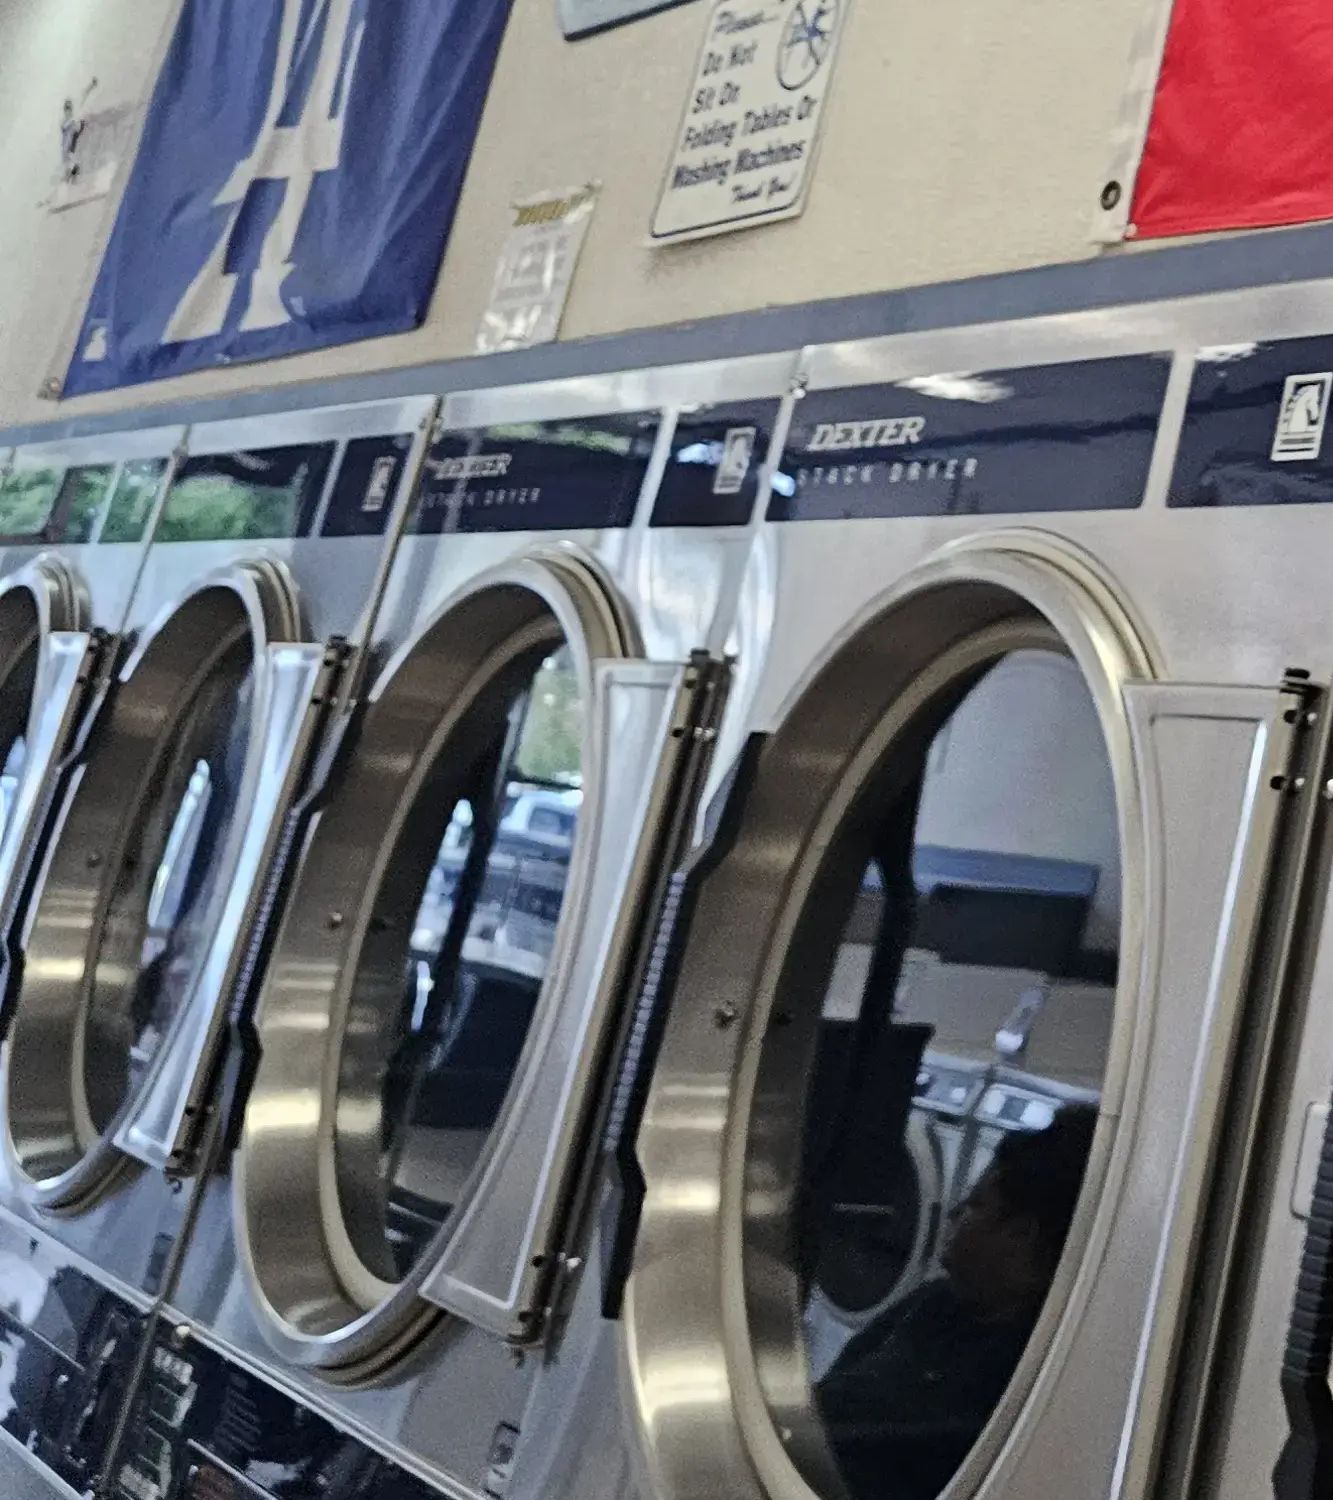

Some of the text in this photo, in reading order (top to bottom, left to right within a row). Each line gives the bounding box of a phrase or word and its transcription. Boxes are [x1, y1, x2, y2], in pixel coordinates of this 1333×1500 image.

[702, 39, 758, 76] Do Not
[680, 119, 737, 152] Folding
[741, 103, 794, 136] Tables
[671, 138, 807, 190] Washing Machines
[807, 415, 926, 452] DEXTER
